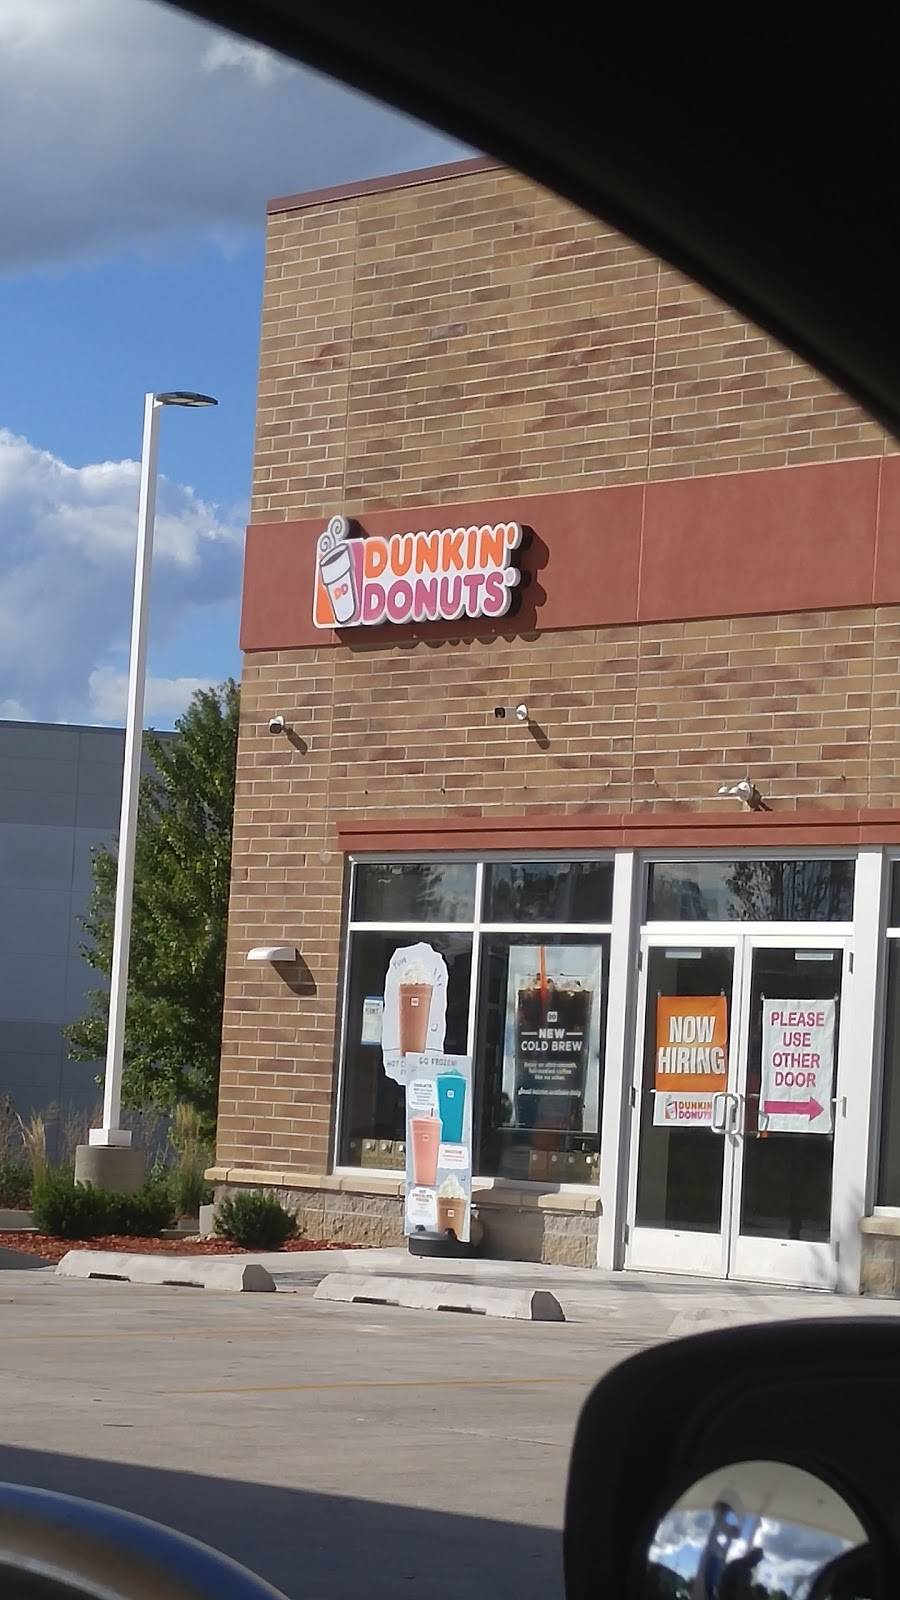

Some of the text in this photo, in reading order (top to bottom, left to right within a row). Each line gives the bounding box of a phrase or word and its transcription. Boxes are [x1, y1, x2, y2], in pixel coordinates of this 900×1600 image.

[364, 525, 516, 579] DUNKIN'
[362, 571, 505, 621] DONUTS
[771, 1011, 825, 1027] PLEASE
[538, 1028, 565, 1039] NEW
[669, 1015, 716, 1043] NOW
[521, 1040, 583, 1052] COLD BREW
[783, 1032, 812, 1047] USE
[657, 1046, 726, 1075] HIRING
[772, 1052, 820, 1068] OTHER
[775, 1071, 817, 1088] DOOR
